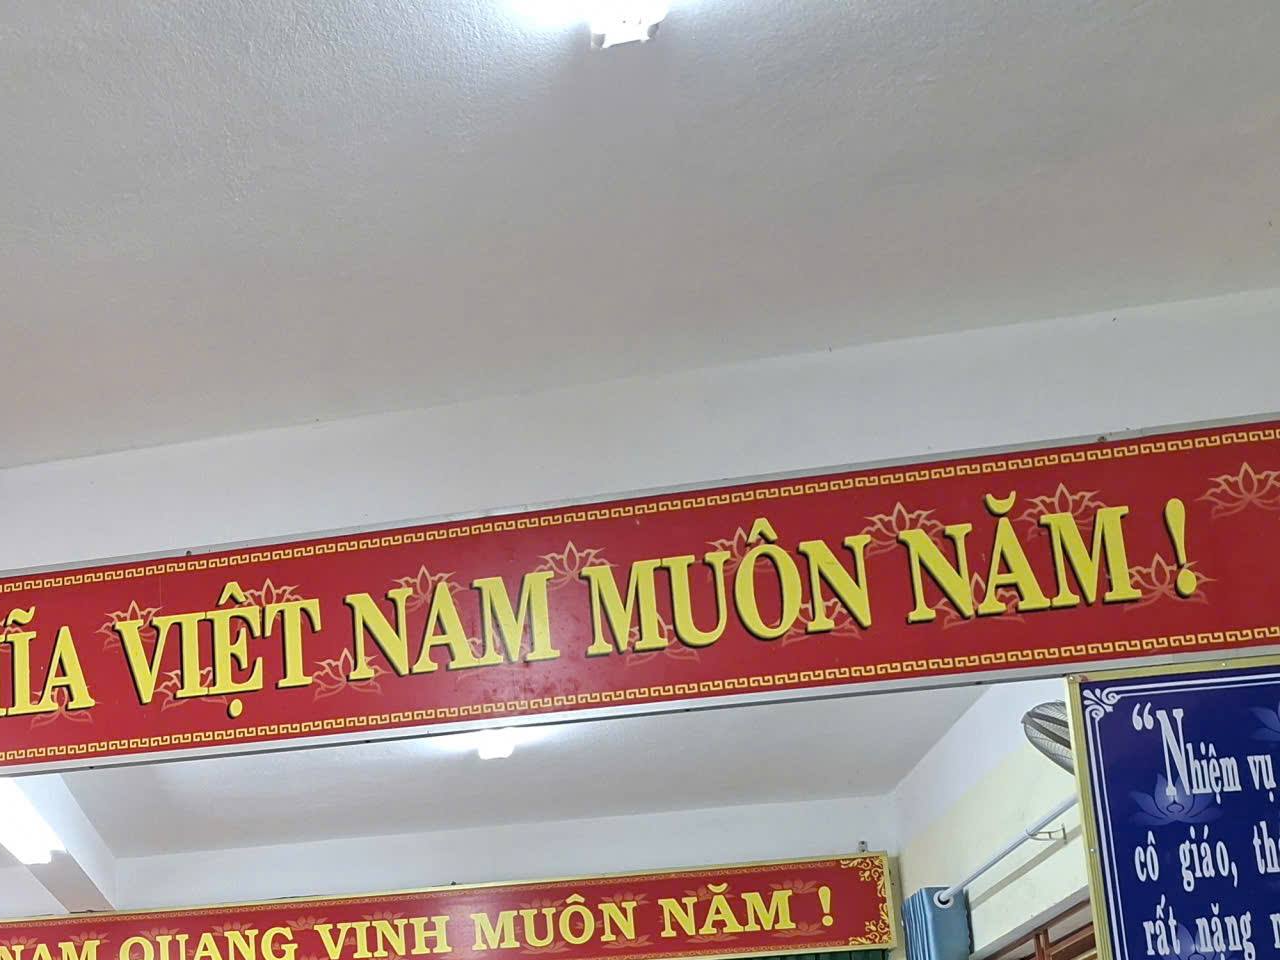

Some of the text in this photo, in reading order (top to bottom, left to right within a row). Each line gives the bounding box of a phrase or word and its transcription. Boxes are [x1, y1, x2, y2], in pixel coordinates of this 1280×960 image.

[112, 583, 323, 719] VIỆT
[344, 568, 561, 684] NAM
[581, 519, 874, 656] MUÔN
[899, 491, 1144, 626] NĂM
[1161, 498, 1199, 598] !
[1132, 702, 1276, 804] “Nhiệm vụ
[1134, 824, 1238, 888] cô giáo,
[313, 912, 452, 960] VINH
[470, 893, 639, 953] MUÔN
[656, 884, 798, 938] NĂM
[816, 885, 836, 926] !
[1143, 894, 1180, 956] rất
